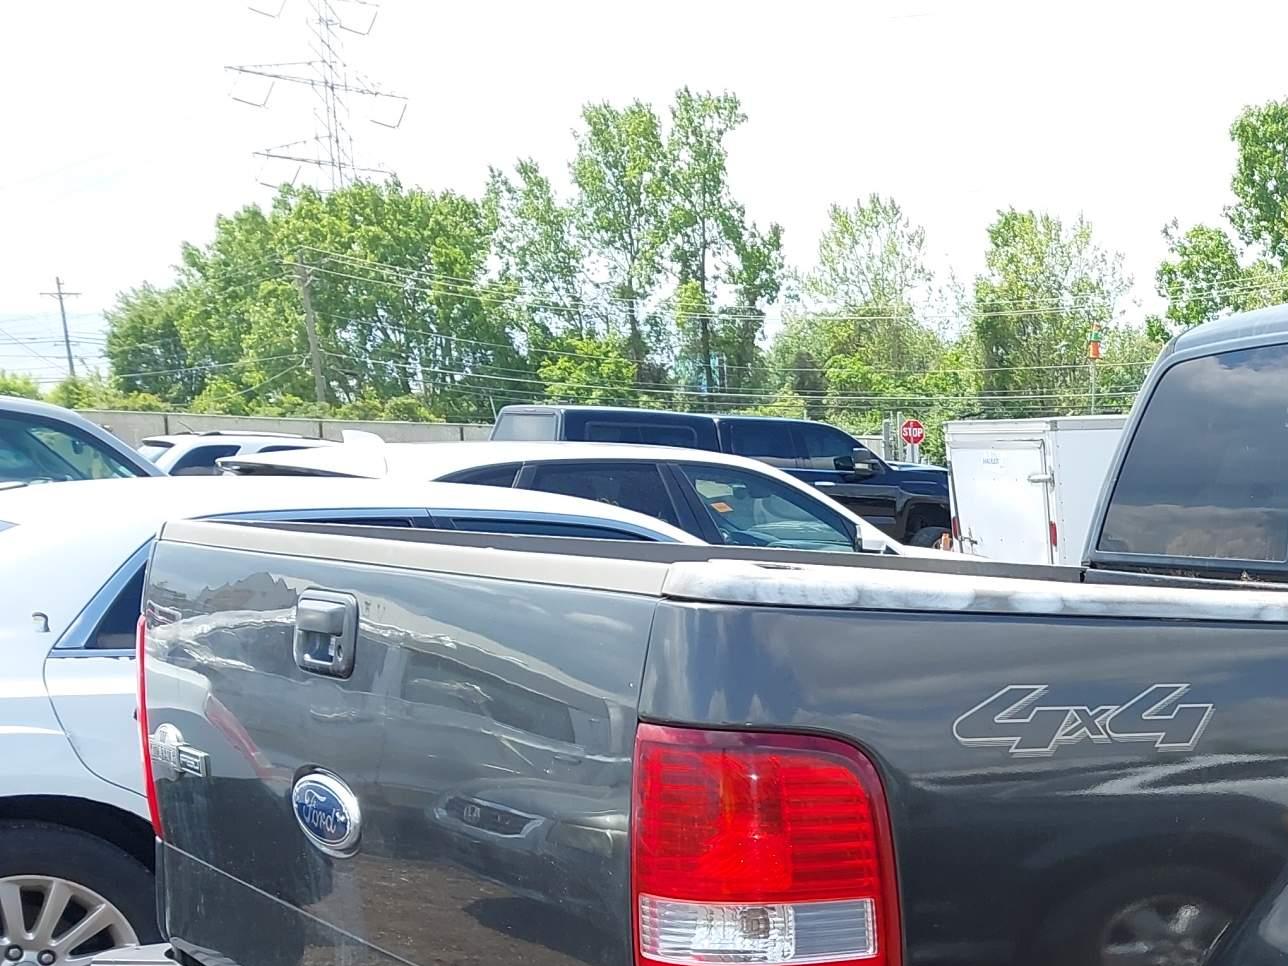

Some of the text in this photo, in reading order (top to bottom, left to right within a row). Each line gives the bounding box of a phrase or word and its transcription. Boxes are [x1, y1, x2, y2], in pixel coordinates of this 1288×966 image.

[902, 427, 923, 438] STOP
[953, 683, 1216, 758] 4x4
[302, 788, 340, 834] Ford
